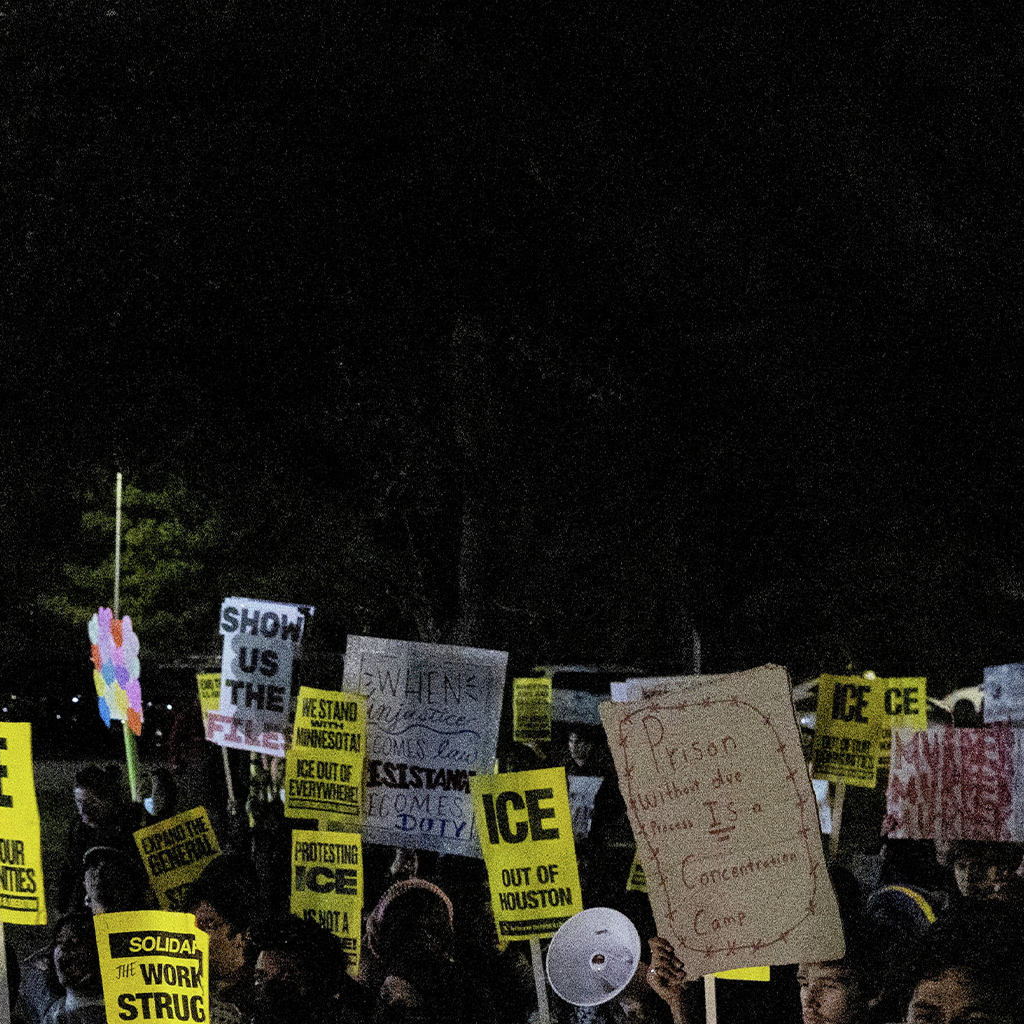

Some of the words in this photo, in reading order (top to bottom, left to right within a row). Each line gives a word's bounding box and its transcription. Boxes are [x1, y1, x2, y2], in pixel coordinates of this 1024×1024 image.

[220, 606, 304, 644] SHOW
[238, 646, 280, 678] US
[225, 679, 286, 713] THE
[376, 667, 462, 704] WHEN
[302, 697, 318, 718] WE
[318, 699, 358, 722] STAND
[832, 682, 871, 724] ICE
[884, 687, 919, 716] CE
[642, 715, 738, 774] Prison
[316, 761, 339, 782] OUT
[340, 763, 354, 783] OF
[712, 768, 743, 791] due
[481, 787, 560, 845] ICE
[141, 823, 186, 854] EXPAND
[184, 816, 210, 837] THE
[0, 837, 25, 865] OUR
[147, 834, 218, 876] GENERAL
[294, 841, 359, 865] PROTESTING
[295, 865, 358, 896] ICE
[501, 867, 532, 888] OUT
[536, 864, 559, 884] OF
[498, 888, 573, 911] HOUSTON
[693, 908, 747, 937] Camp
[117, 991, 206, 1023] STRUG
